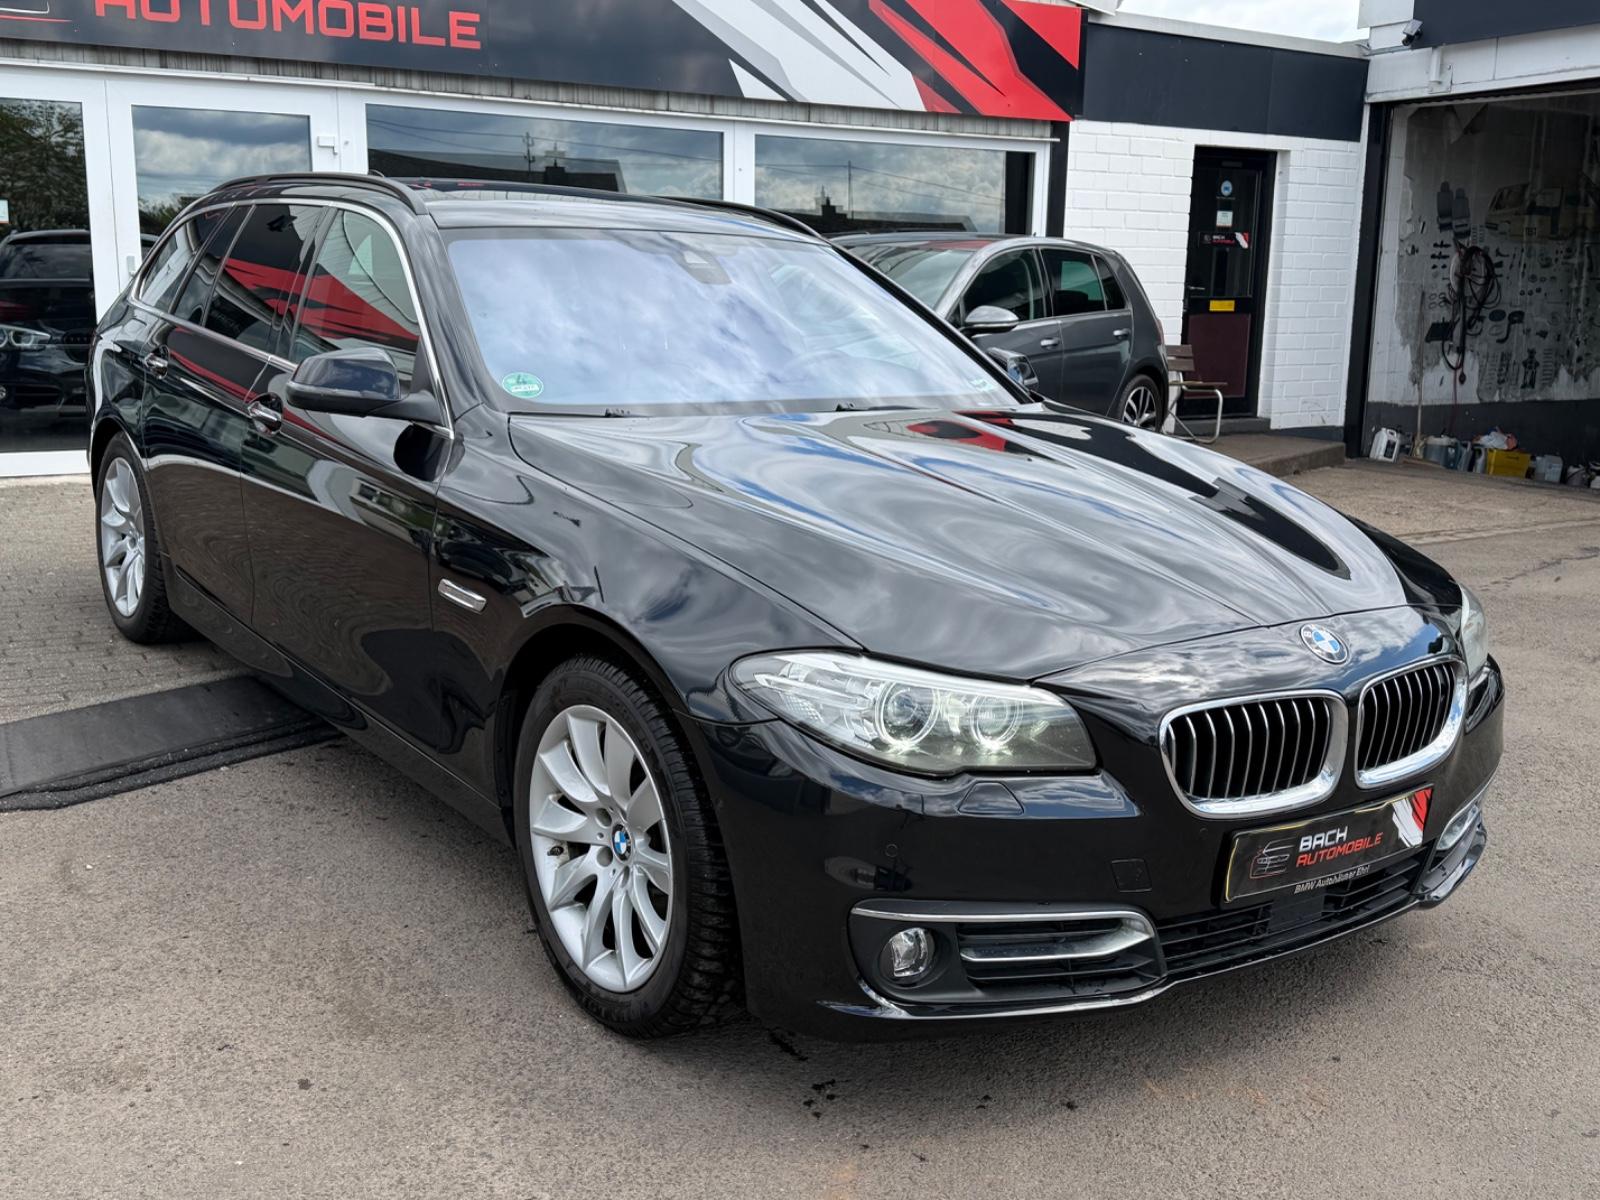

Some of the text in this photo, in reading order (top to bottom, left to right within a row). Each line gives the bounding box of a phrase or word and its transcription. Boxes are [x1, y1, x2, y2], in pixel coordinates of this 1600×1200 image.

[1296, 832, 1383, 868] AUTOMOBILE
[1299, 826, 1348, 852] BACH
[1294, 880, 1316, 894] BMW
